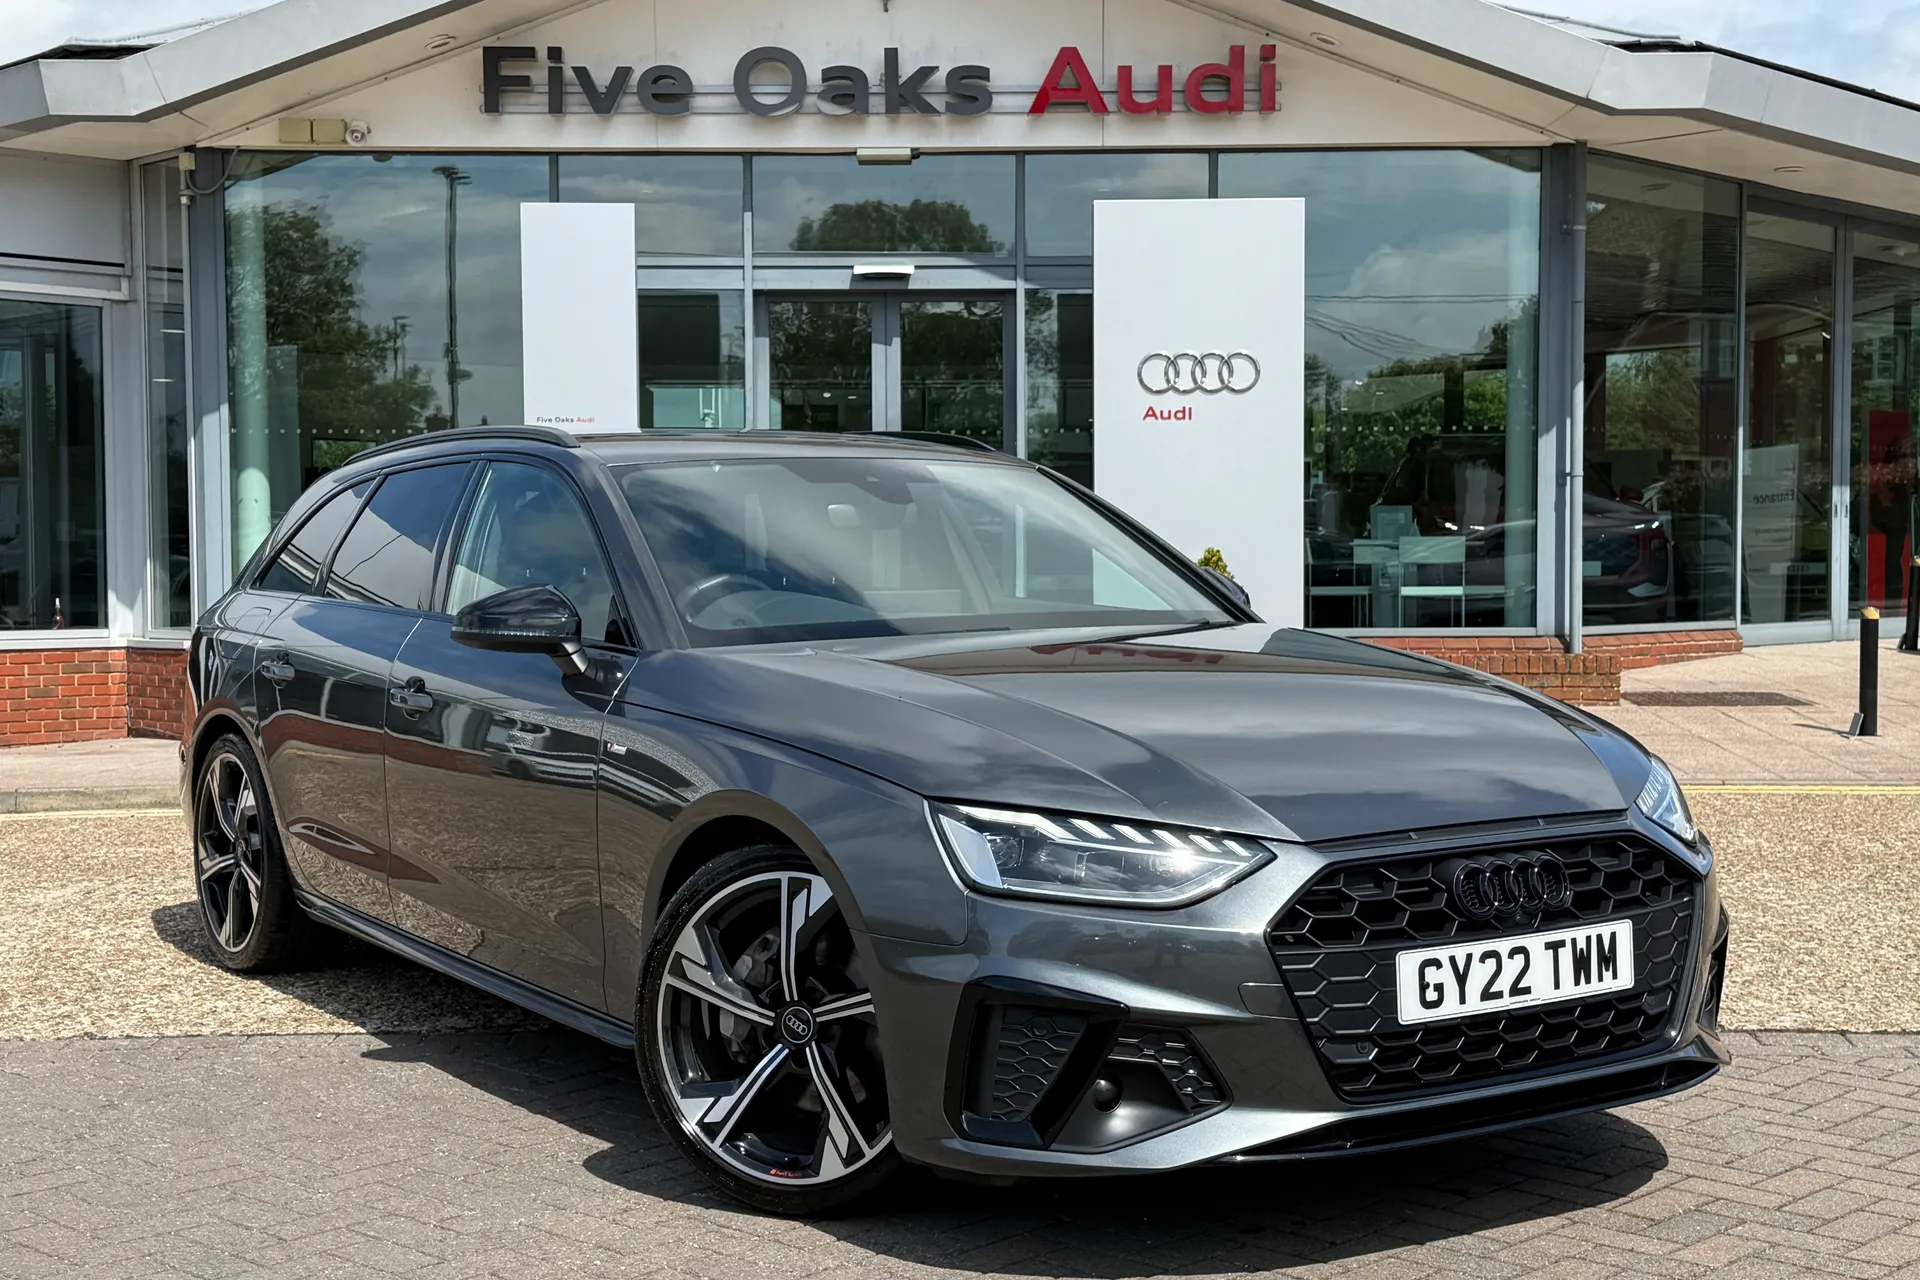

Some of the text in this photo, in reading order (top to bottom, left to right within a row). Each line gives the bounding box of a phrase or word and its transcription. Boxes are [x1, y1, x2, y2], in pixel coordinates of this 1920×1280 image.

[482, 44, 1277, 117] Five Oaks Audi
[1142, 406, 1193, 421] Audi
[1418, 931, 1618, 1010] GY22 TWM
